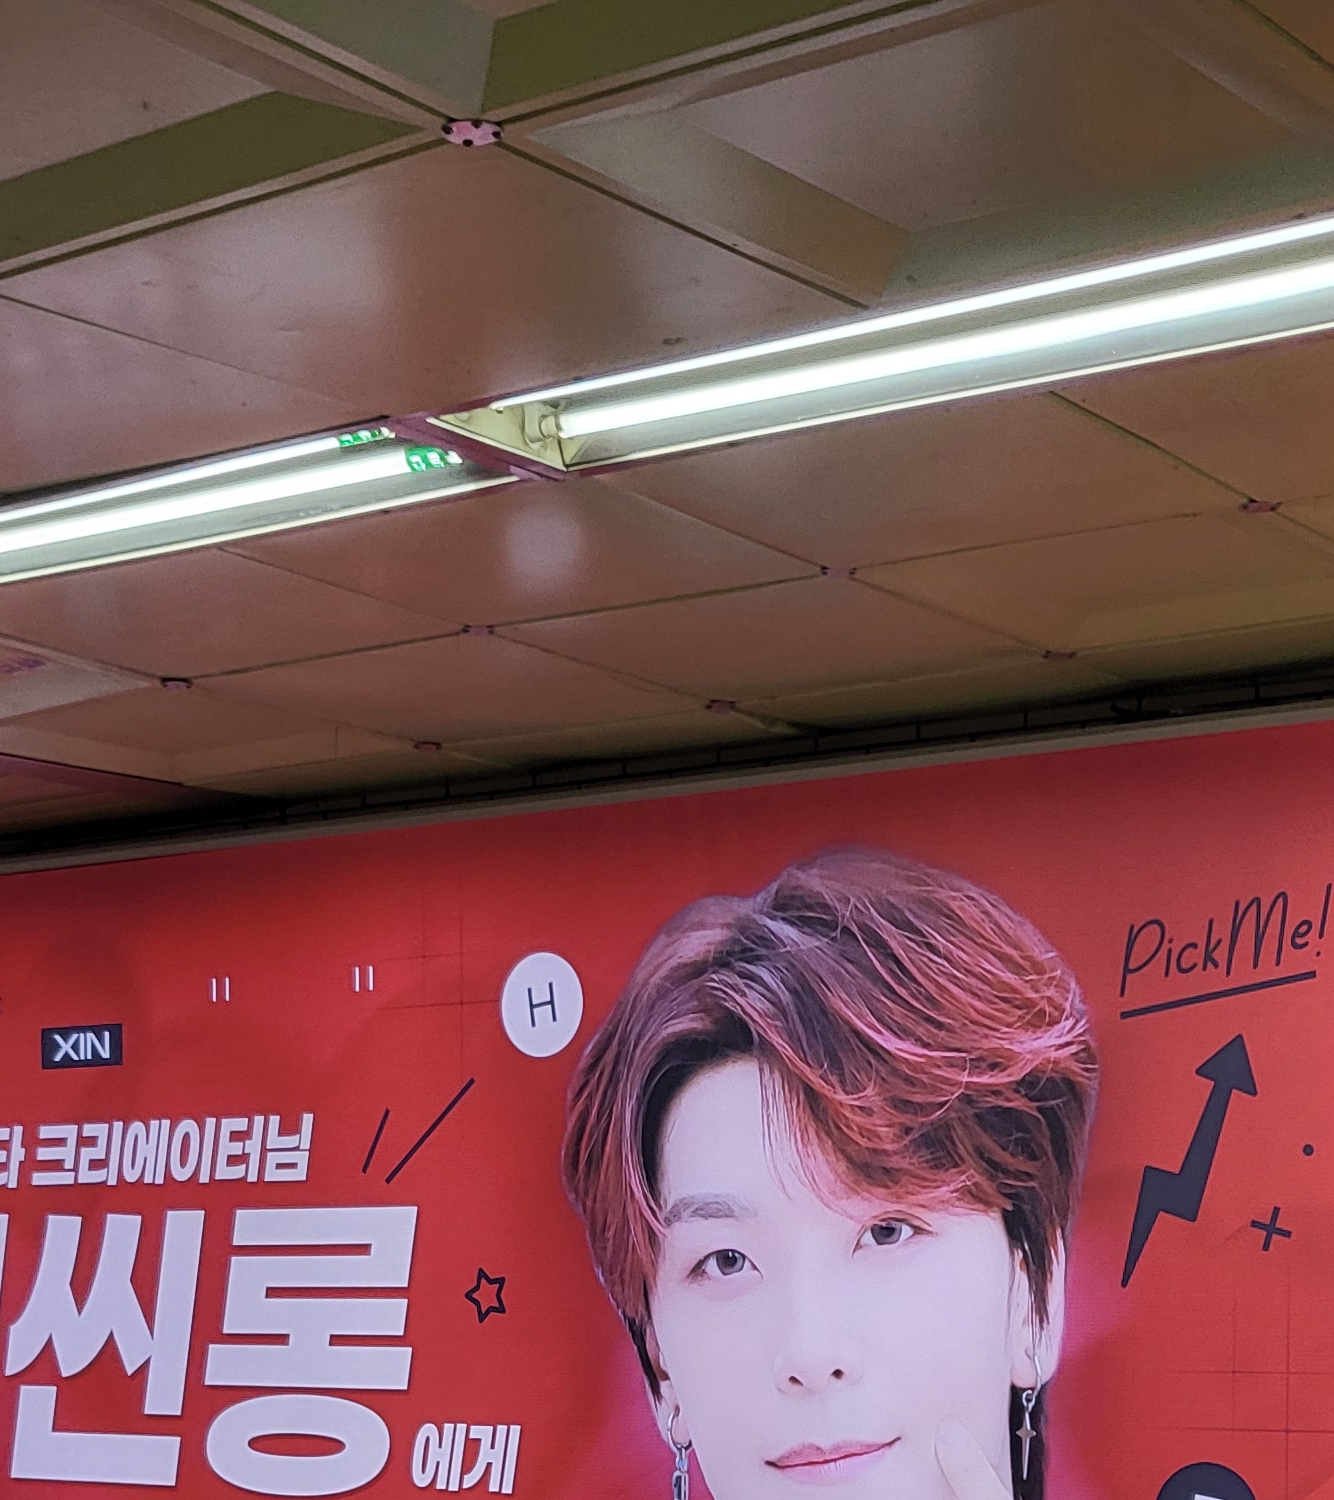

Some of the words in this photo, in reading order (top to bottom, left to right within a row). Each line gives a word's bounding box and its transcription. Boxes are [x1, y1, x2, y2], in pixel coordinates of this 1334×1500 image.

[528, 981, 560, 1028] H
[53, 1031, 111, 1062] XIN
[30, 1113, 315, 1188] 크리에이터님
[410, 1422, 521, 1496] 에게
